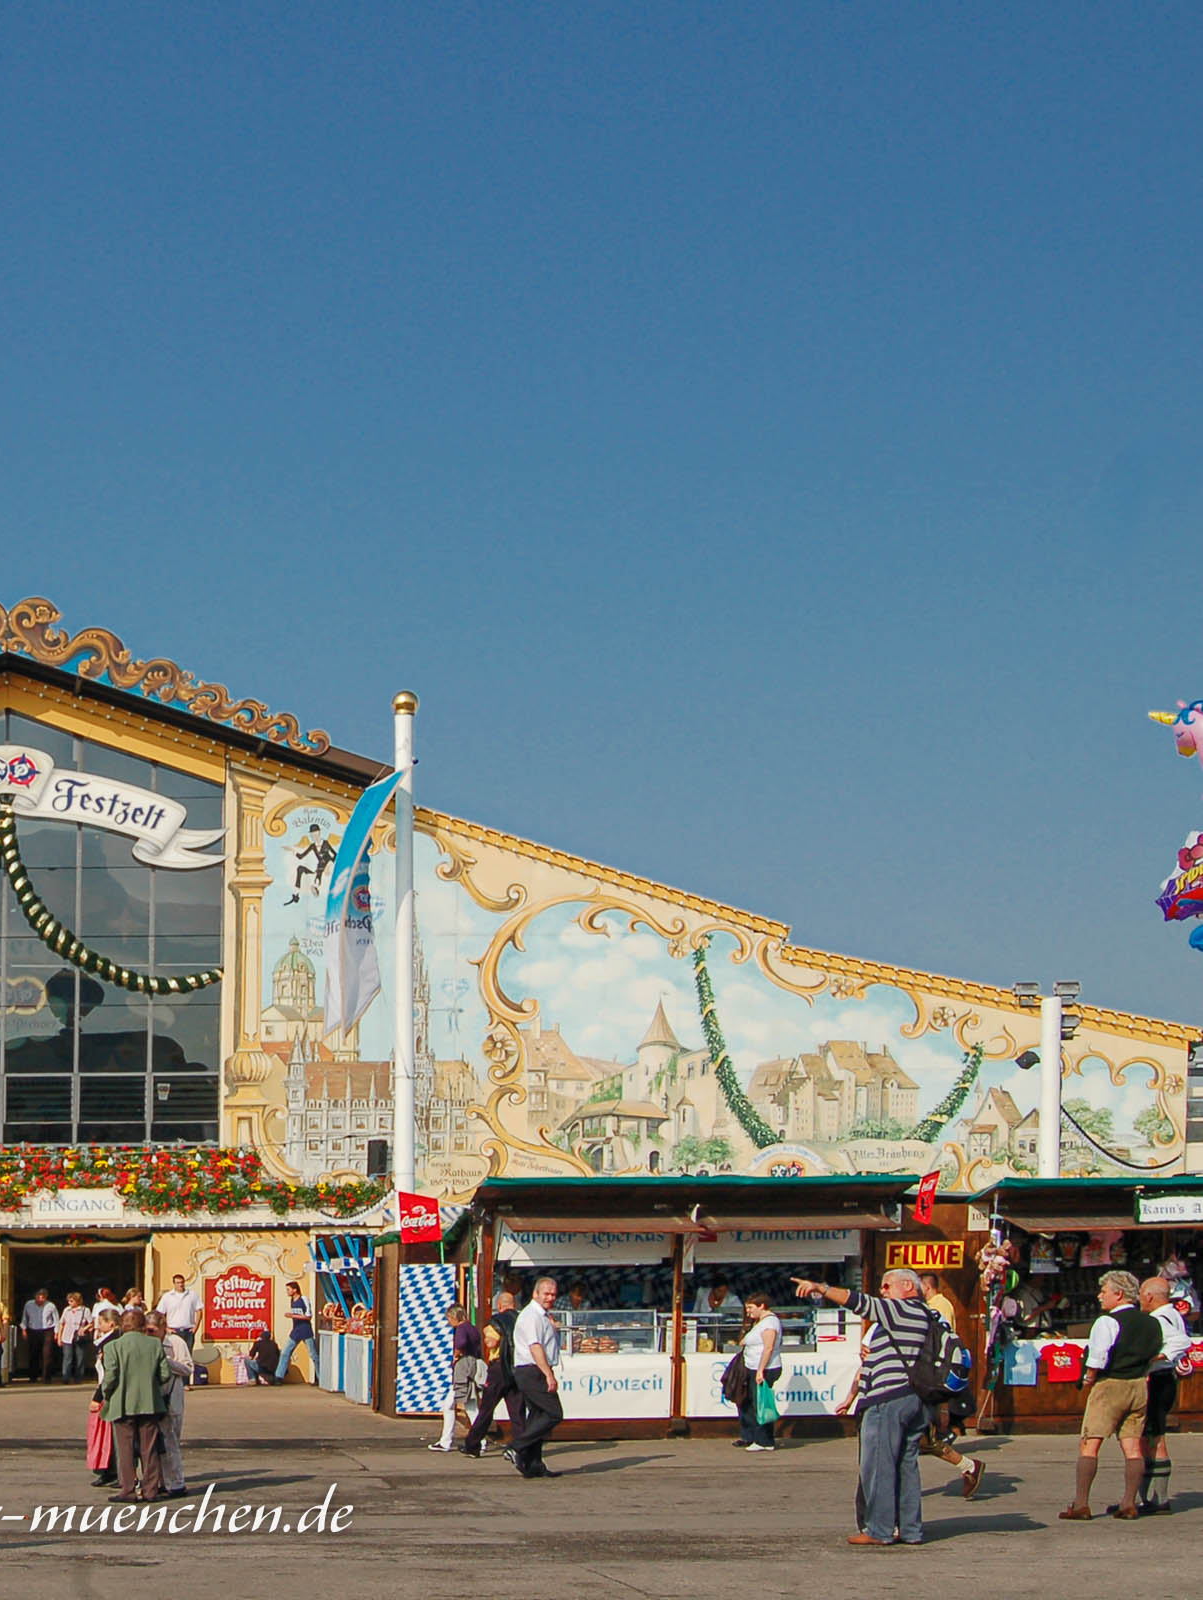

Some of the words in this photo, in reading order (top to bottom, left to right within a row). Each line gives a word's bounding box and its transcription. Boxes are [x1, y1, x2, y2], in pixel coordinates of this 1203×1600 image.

[52, 778, 167, 830] Festzelt
[38, 1198, 116, 1213] EINGANG
[1141, 1203, 1185, 1215] Karin's
[402, 1213, 438, 1229] Coca-Cola
[888, 1244, 961, 1265] FILME
[792, 1360, 828, 1376] und
[580, 1374, 664, 1397] Brotzeit
